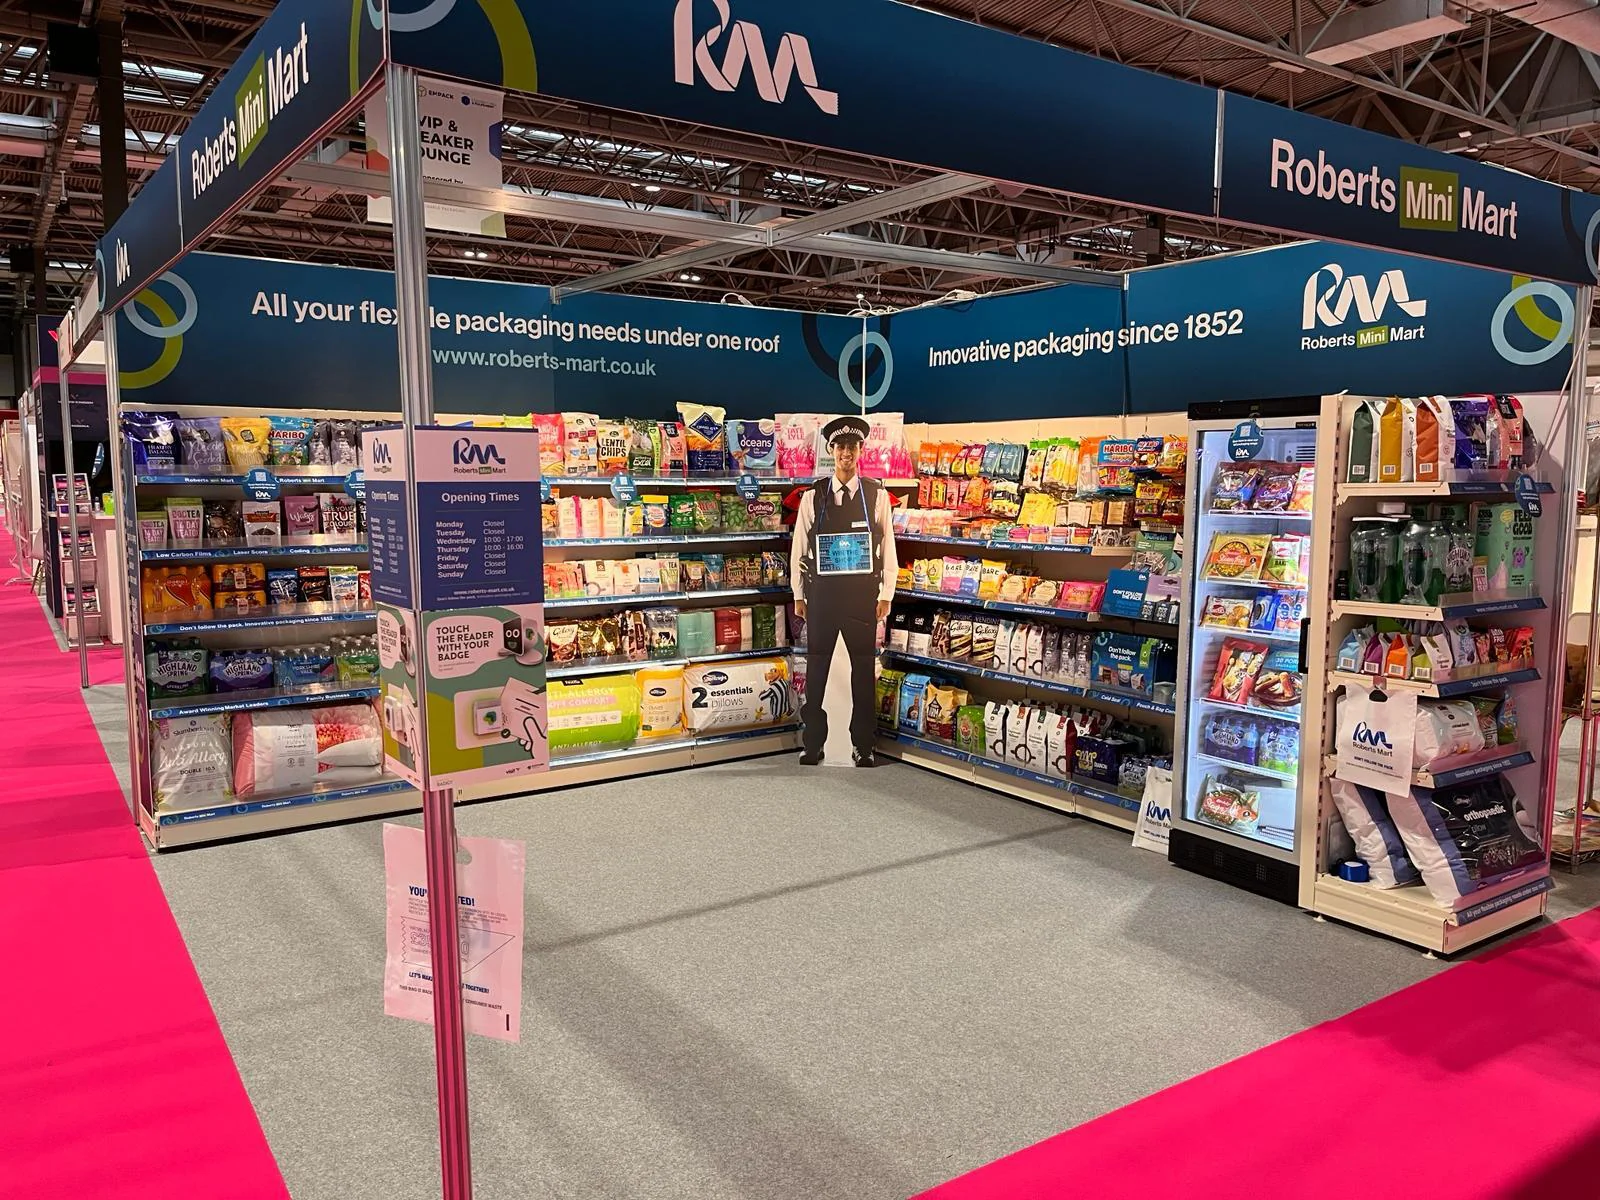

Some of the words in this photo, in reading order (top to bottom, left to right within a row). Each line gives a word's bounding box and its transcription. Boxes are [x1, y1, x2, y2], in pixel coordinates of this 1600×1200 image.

[428, 89, 454, 99] EMPACK
[191, 117, 236, 199] Roberts
[239, 75, 265, 152] Mini
[268, 22, 309, 120] Mart
[448, 120, 458, 132] &
[1271, 138, 1396, 213] Roberts
[1406, 181, 1452, 222] Mini
[1462, 187, 1517, 239] Mart
[252, 291, 287, 316] All
[293, 300, 355, 323] your
[455, 311, 574, 342] packaging
[578, 322, 641, 343] needs
[645, 326, 702, 348] under
[706, 333, 741, 351] one
[745, 334, 780, 353] roof
[929, 338, 1010, 367] Innovative
[1014, 327, 1114, 362] packaging
[1118, 321, 1179, 347] since
[1184, 309, 1244, 339] 1852
[1301, 332, 1356, 350] Roberts
[1359, 329, 1386, 346] Mini
[1390, 324, 1425, 341] Mart
[432, 349, 656, 376] www.roberts-mart.co.uk
[268, 430, 305, 439] HARIBO
[600, 438, 627, 447] LENTIL
[740, 439, 772, 448] oceans
[600, 446, 627, 457] CHIPS
[441, 492, 486, 505] Opening
[489, 491, 520, 502] Times
[323, 511, 355, 520] TRUE
[436, 520, 464, 529] Monday
[1513, 522, 1532, 536] GOOD
[436, 529, 465, 537] Tuesday
[483, 528, 505, 536] Closed
[436, 537, 477, 545] Wednesday
[437, 545, 469, 554] Thursday
[437, 554, 459, 562] Friday
[437, 562, 469, 570] Saturday
[982, 568, 1000, 576] BARE
[275, 618, 304, 626] packaging
[436, 625, 470, 634] TOUCH
[975, 625, 999, 639] Galaxy
[437, 635, 456, 643] THE
[457, 631, 494, 642] READER
[437, 643, 461, 652] WITH
[463, 640, 490, 650] YOUR
[438, 651, 470, 661] BADGE
[1121, 647, 1137, 656] follow
[156, 660, 197, 676] HIGHLAND
[166, 669, 189, 677] SPRING
[225, 661, 262, 676] HIGHLAND
[691, 687, 708, 708] 2
[710, 687, 753, 697] essentials
[711, 697, 744, 709] pillows
[179, 707, 199, 715] Award
[199, 705, 224, 713] Winning
[1352, 742, 1376, 754] Roberts
[1377, 749, 1393, 757] Mart
[179, 767, 202, 775] DOUBLE
[1475, 765, 1494, 775] packaging
[1463, 805, 1507, 822] orthopaedic
[1494, 897, 1512, 910] packaging
